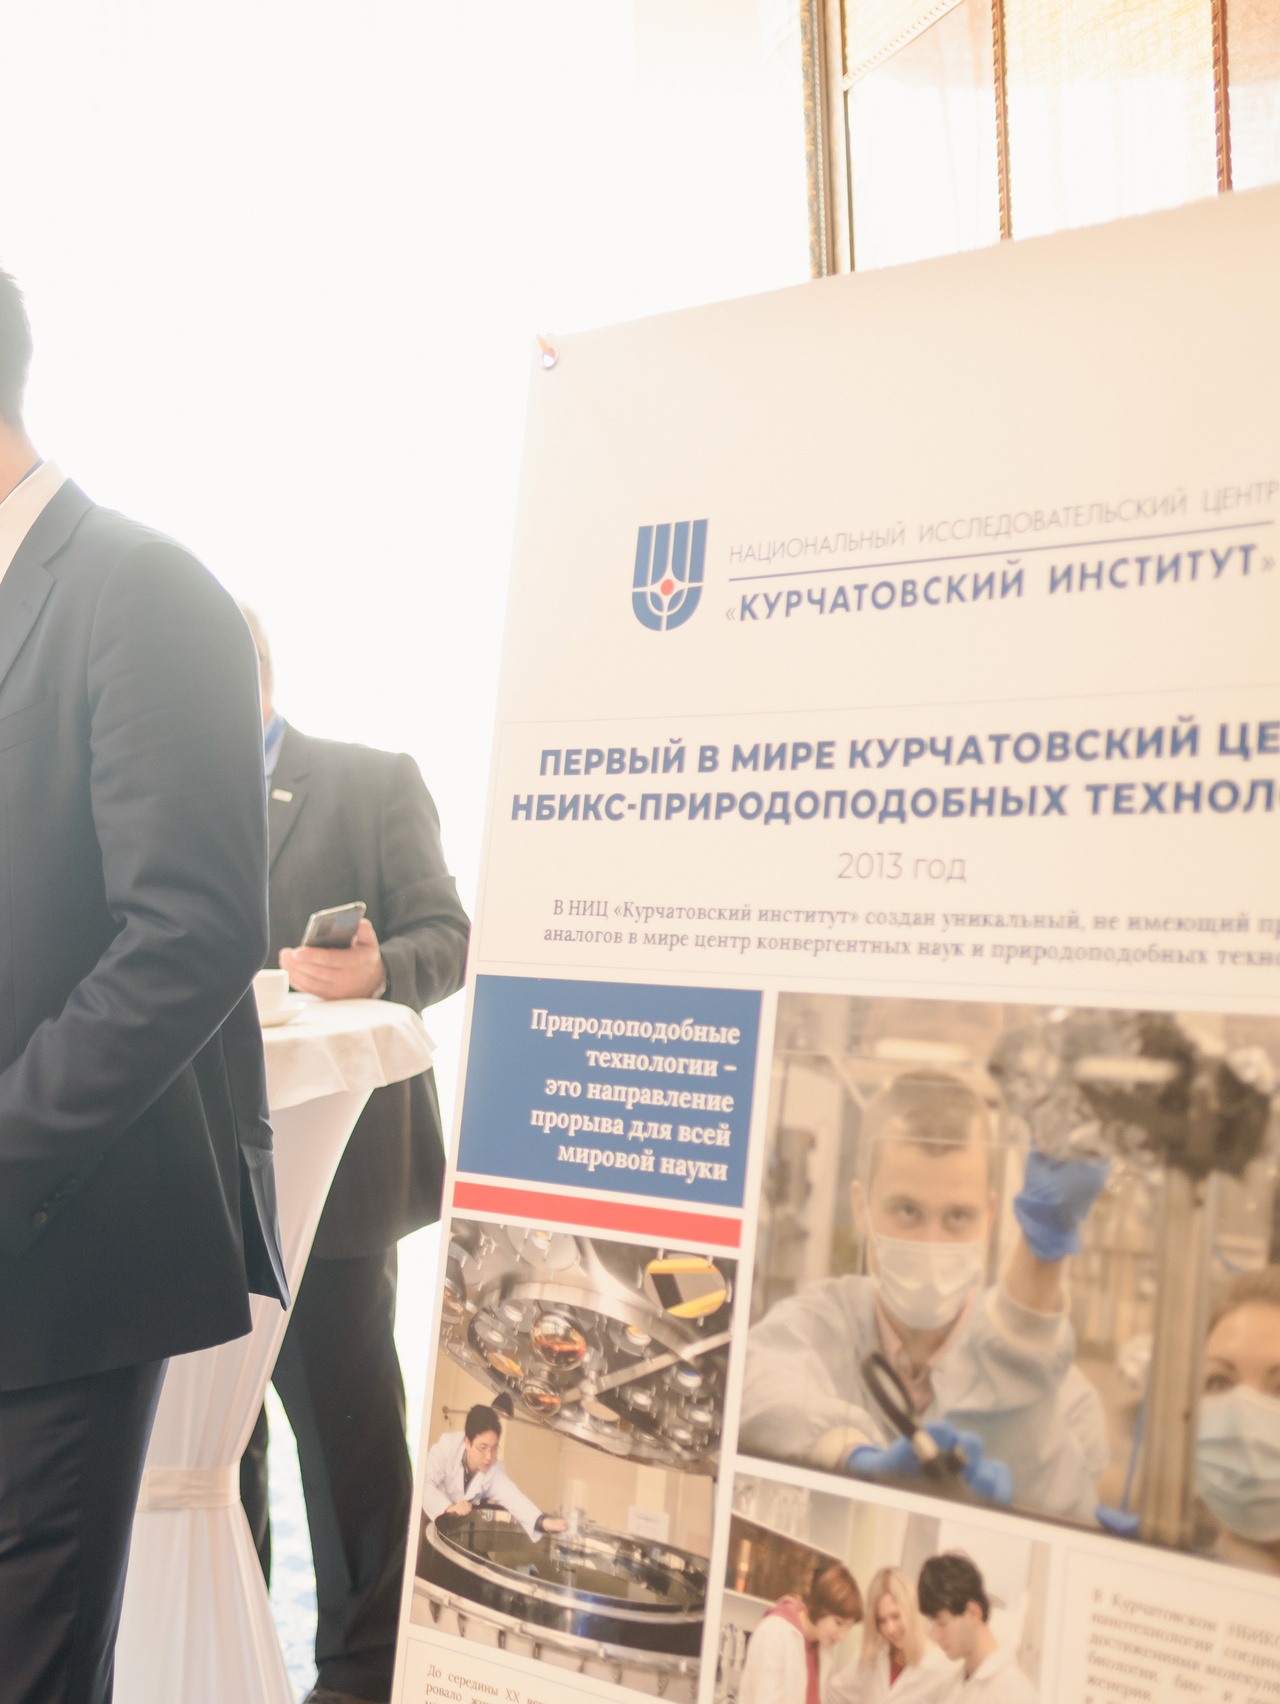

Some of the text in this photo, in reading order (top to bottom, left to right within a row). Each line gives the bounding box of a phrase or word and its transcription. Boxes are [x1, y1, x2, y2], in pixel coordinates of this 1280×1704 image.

[729, 480, 1280, 564] НАЦИОНАЛЬНЫЙ ИССЛЕДОВАТЕЛЬСКИЙ ЦЕНТР
[726, 543, 1276, 621] «КУРЧАТОВСКИЙ ИНСТИТУТ»
[539, 714, 1280, 776] ПЕРВЫЙ В МИРЕ КУРЧАТОВСКИЙ ЦЕ
[511, 778, 1280, 826] НБИКС-ПРИРОДОПОДОБНЫХ ТЕХНОЛ
[837, 852, 967, 883] 2013 год
[553, 899, 564, 916] В
[568, 900, 609, 920] НИЦ
[613, 901, 752, 923] «Курчатовский
[758, 907, 858, 928] институт»
[865, 910, 936, 928] создан
[942, 909, 1085, 932] уникальный,
[1093, 914, 1120, 930] не
[1128, 911, 1251, 936] имеющий
[544, 928, 623, 944] аналогов
[628, 931, 638, 944] в
[643, 931, 689, 951] мире
[695, 934, 751, 954] центр
[756, 935, 912, 957] конвергентных
[917, 942, 966, 961] наук
[972, 944, 984, 957] и
[991, 943, 1209, 966] природоподобных
[530, 1008, 741, 1045] Природоподобные
[586, 1050, 718, 1077] технологии
[545, 1078, 734, 1112] это направление
[530, 1110, 731, 1147] прорыва для всей
[557, 1144, 728, 1184] мировой науки
[426, 1683, 462, 1702] ровало
[427, 1664, 442, 1678] До
[447, 1673, 499, 1696] середины
